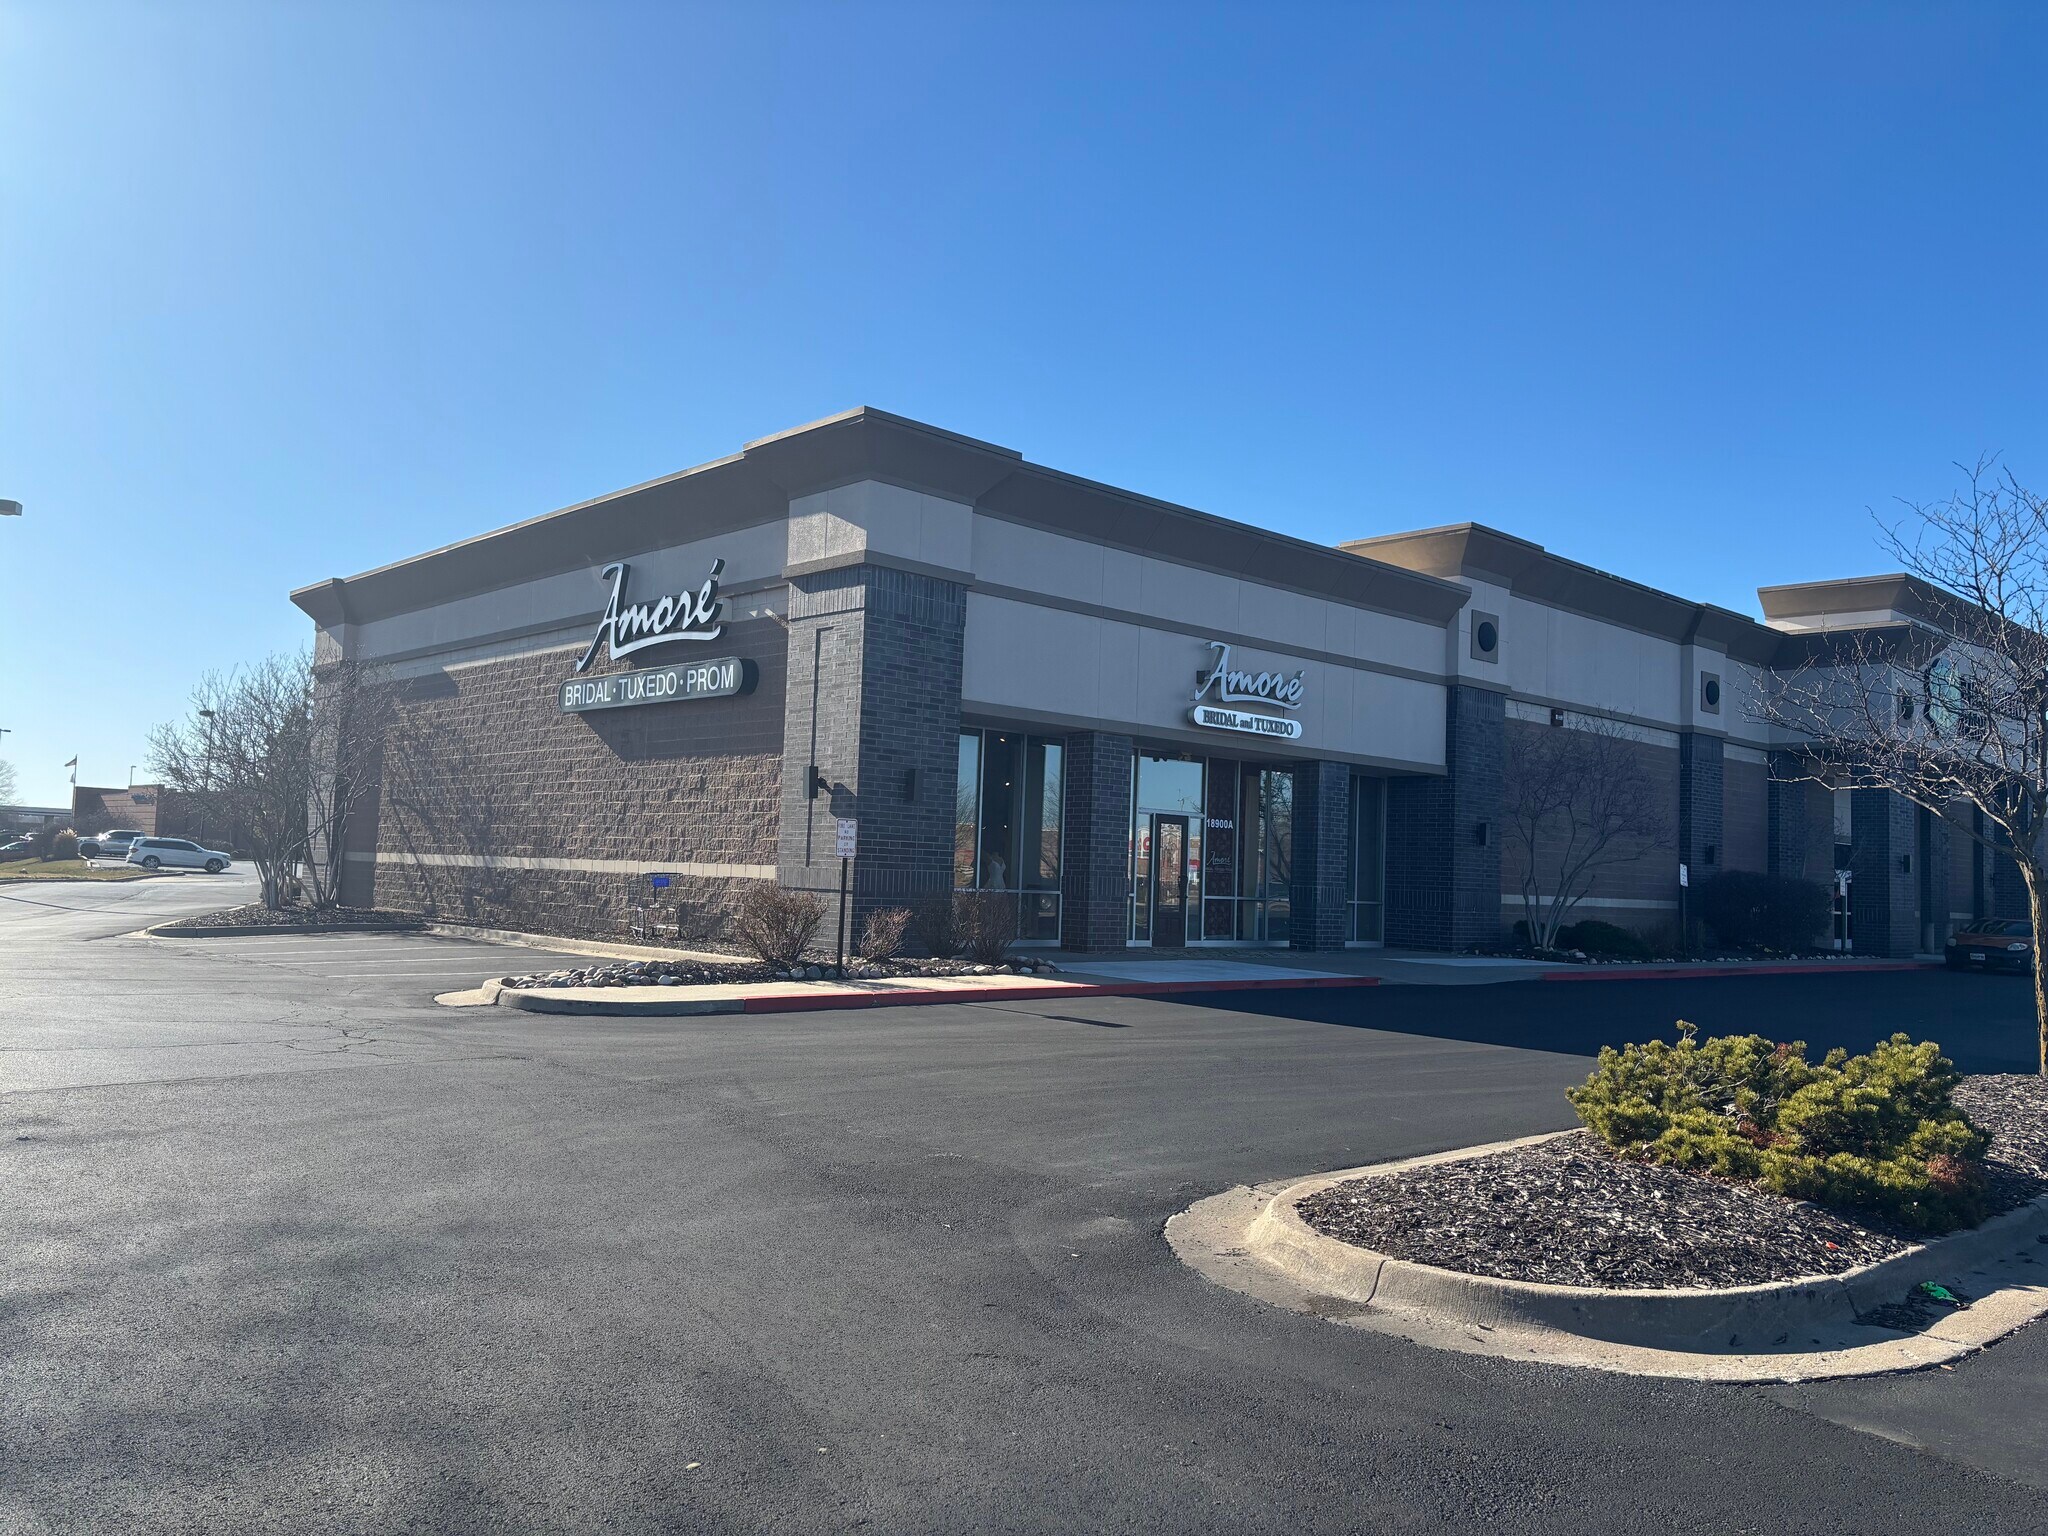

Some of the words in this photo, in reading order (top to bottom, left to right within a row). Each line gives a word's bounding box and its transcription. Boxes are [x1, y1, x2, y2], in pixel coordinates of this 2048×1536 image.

[576, 558, 724, 672] Amoré
[565, 681, 611, 706] BRIDAL
[619, 672, 677, 700] TUXEDO
[686, 664, 734, 693] PROM
[1194, 641, 1305, 710] Amoré
[1202, 709, 1239, 728] BRIDAL
[1240, 717, 1254, 729] and
[1254, 717, 1294, 736] TUXEDO
[1206, 818, 1234, 829] 18900A
